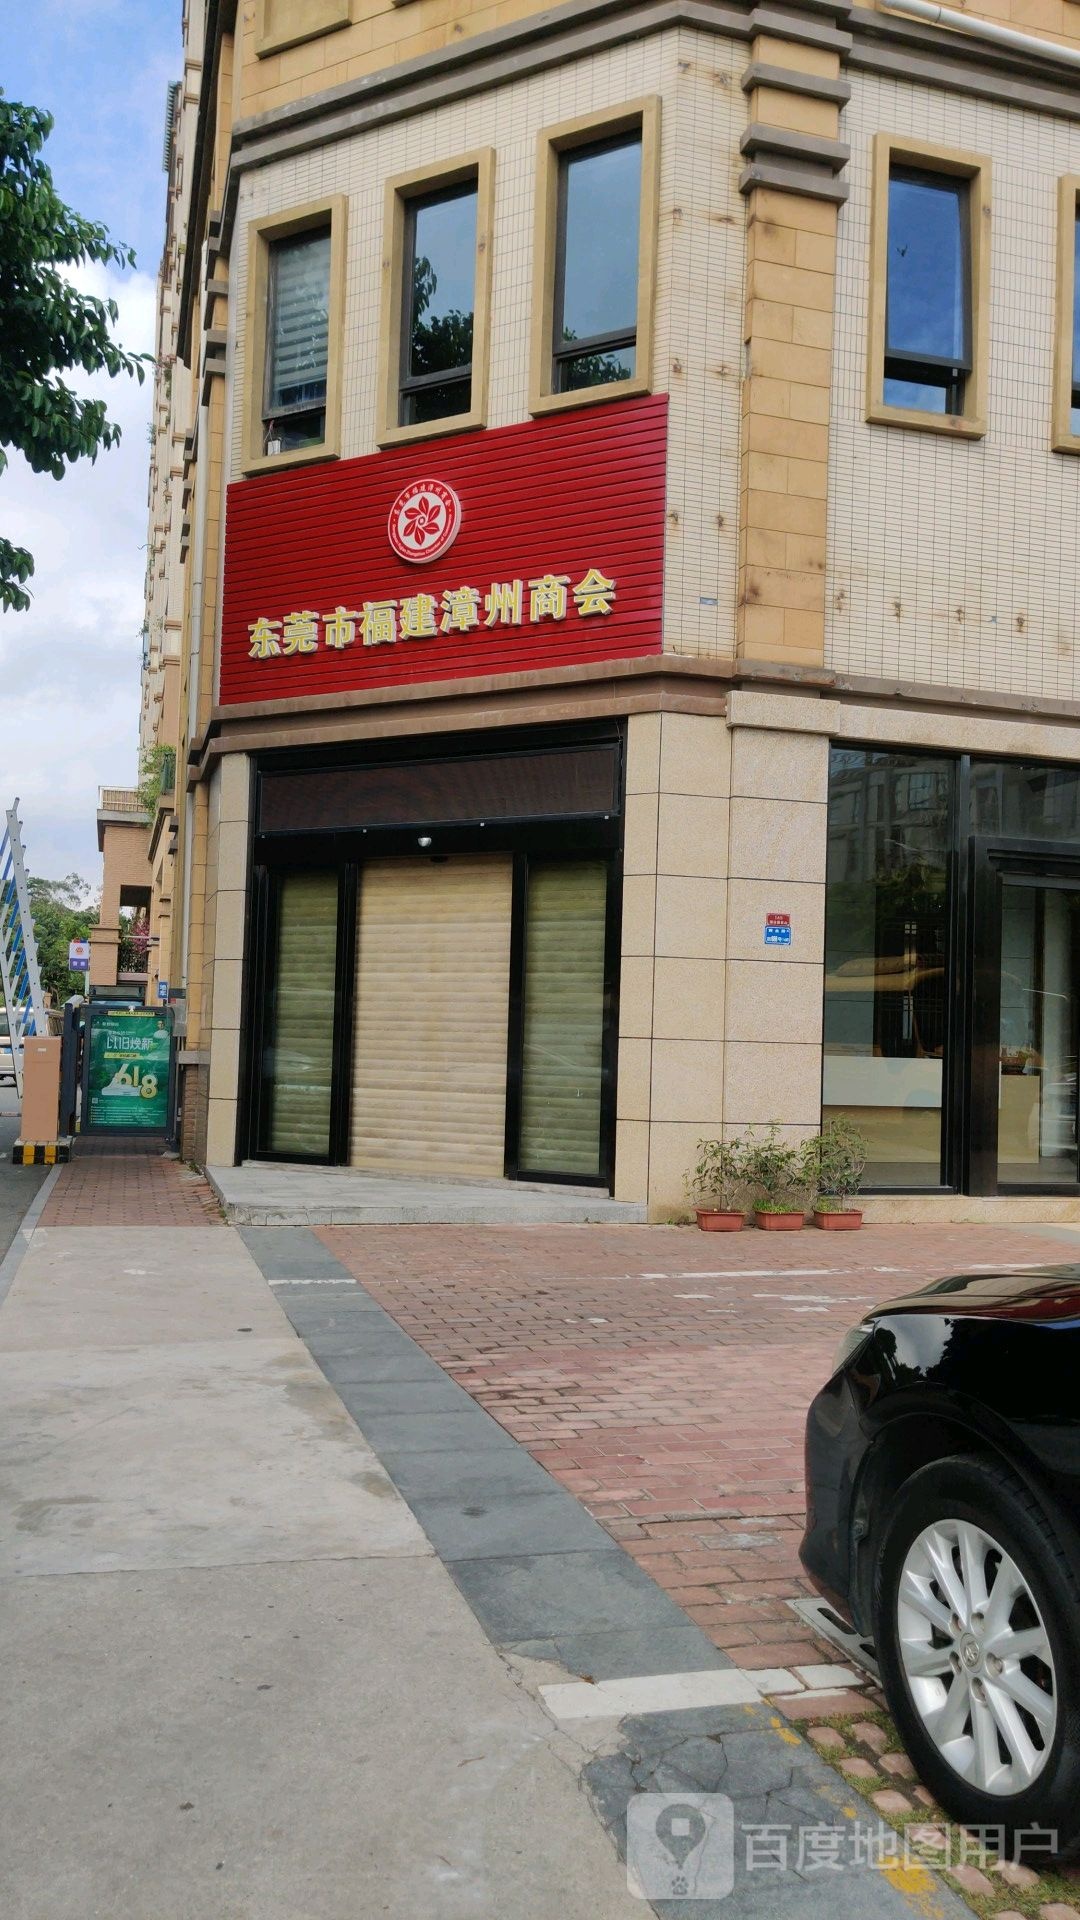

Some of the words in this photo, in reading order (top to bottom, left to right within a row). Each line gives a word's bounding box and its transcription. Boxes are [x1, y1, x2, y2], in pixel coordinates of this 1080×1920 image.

[248, 568, 617, 660] 东莞市福建漳州商会
[113, 1063, 158, 1099] 618
